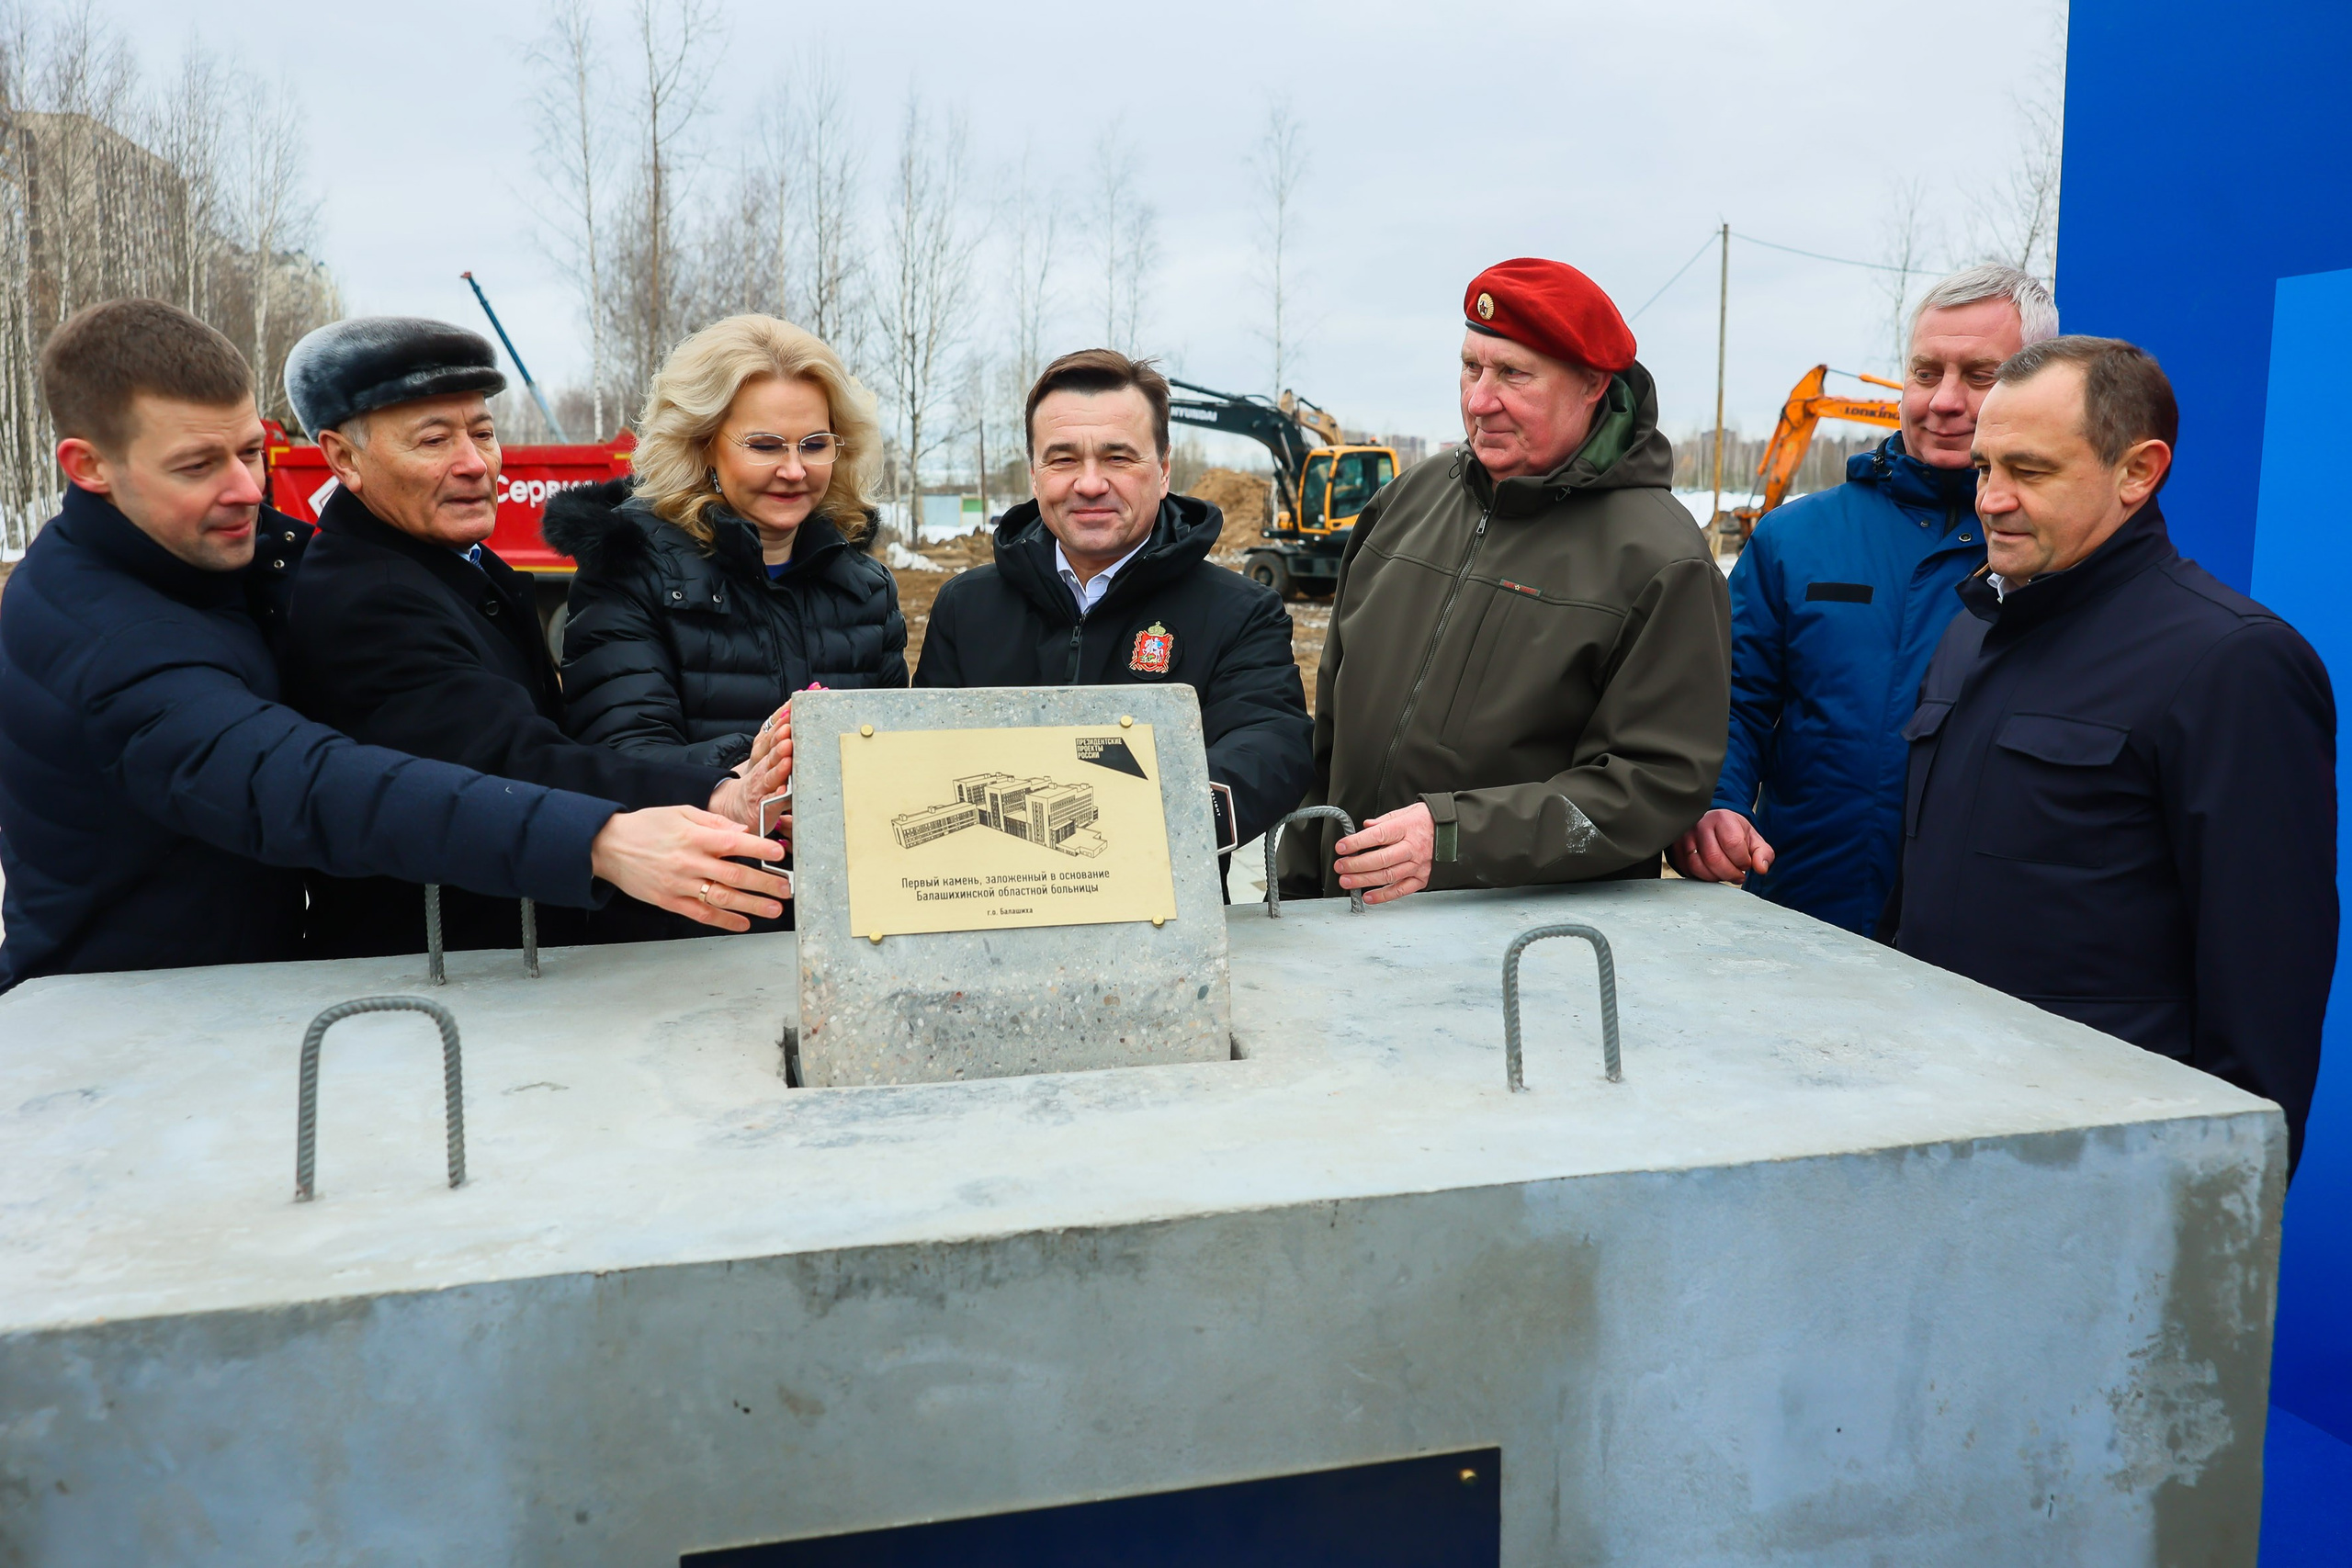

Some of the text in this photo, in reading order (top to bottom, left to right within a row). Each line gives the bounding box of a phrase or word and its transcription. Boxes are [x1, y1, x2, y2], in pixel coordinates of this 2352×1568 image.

[1170, 405, 1217, 423] HYUNDAI
[1076, 738, 1123, 746] ПРЕЗИДЕНТСКИЕ
[1077, 744, 1104, 752] ПРОЕКТЫ
[1078, 751, 1101, 760] РОССИИ
[901, 870, 1110, 890] Первый камень, заложенный в основание
[916, 883, 1099, 902] Балашихинской областной больницы
[1000, 908, 1034, 916] Балашиха
